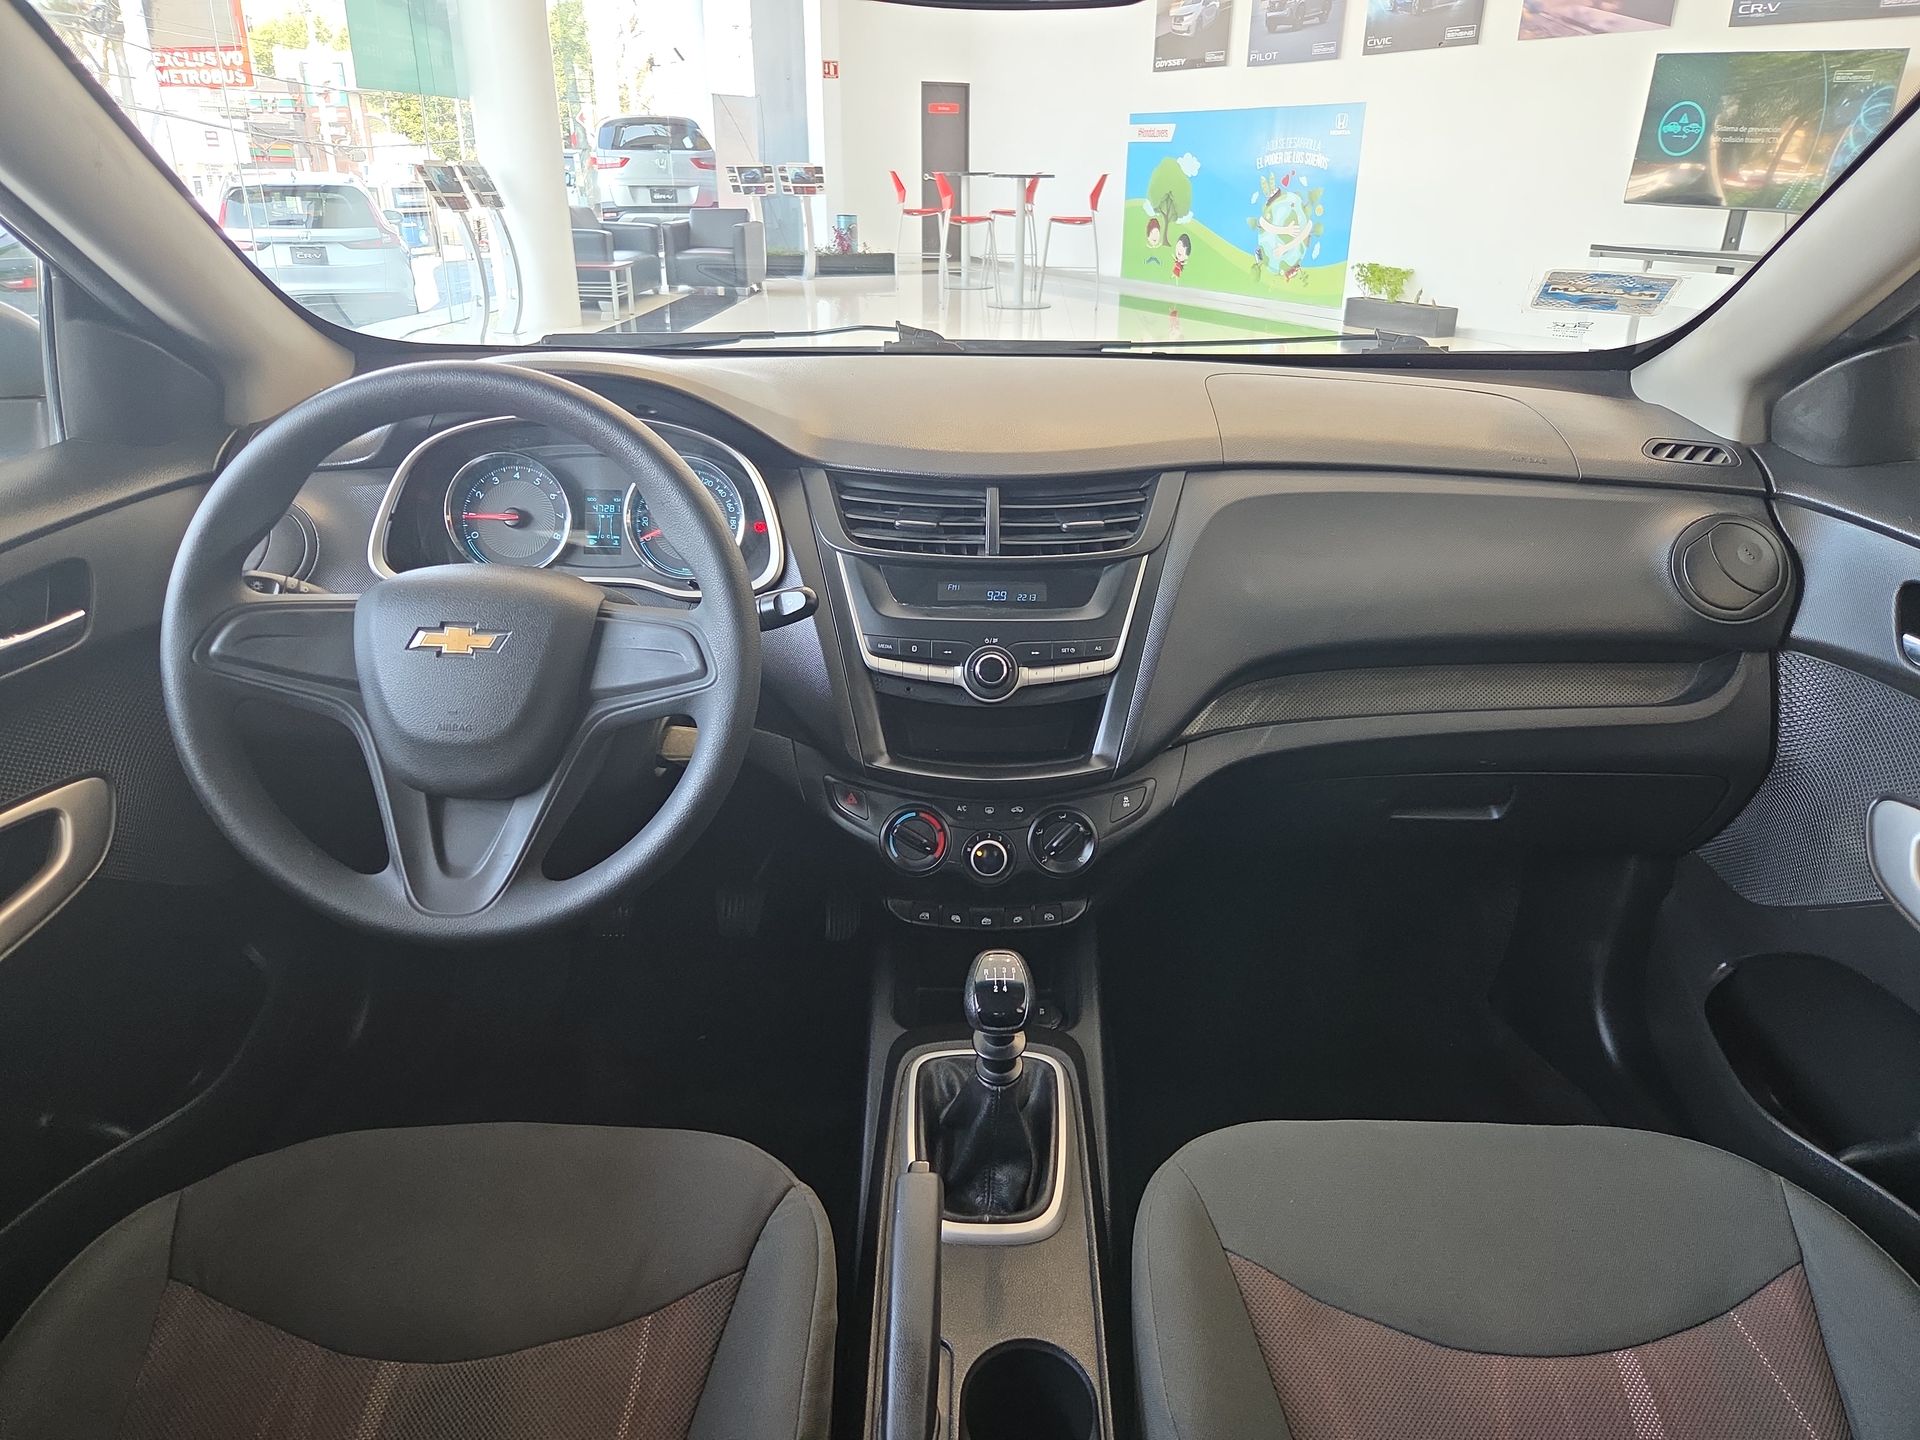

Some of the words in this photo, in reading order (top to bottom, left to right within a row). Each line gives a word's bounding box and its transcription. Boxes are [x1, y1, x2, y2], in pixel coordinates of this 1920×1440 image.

[1738, 2, 1781, 14] CR-V
[1366, 36, 1393, 47] CIVIC
[153, 51, 244, 67] EXCLUSVO
[1249, 51, 1279, 62] PILOT
[1154, 58, 1187, 68] ODYSSEY
[157, 69, 247, 84] METROBUS
[492, 476, 500, 485] 3
[533, 477, 541, 486] 5
[475, 491, 484, 499] 2
[715, 485, 727, 498] 140
[593, 504, 621, 513] 47281
[726, 499, 735, 513] 160
[641, 516, 649, 527] 20
[471, 531, 479, 539] 0
[552, 532, 561, 540] 8
